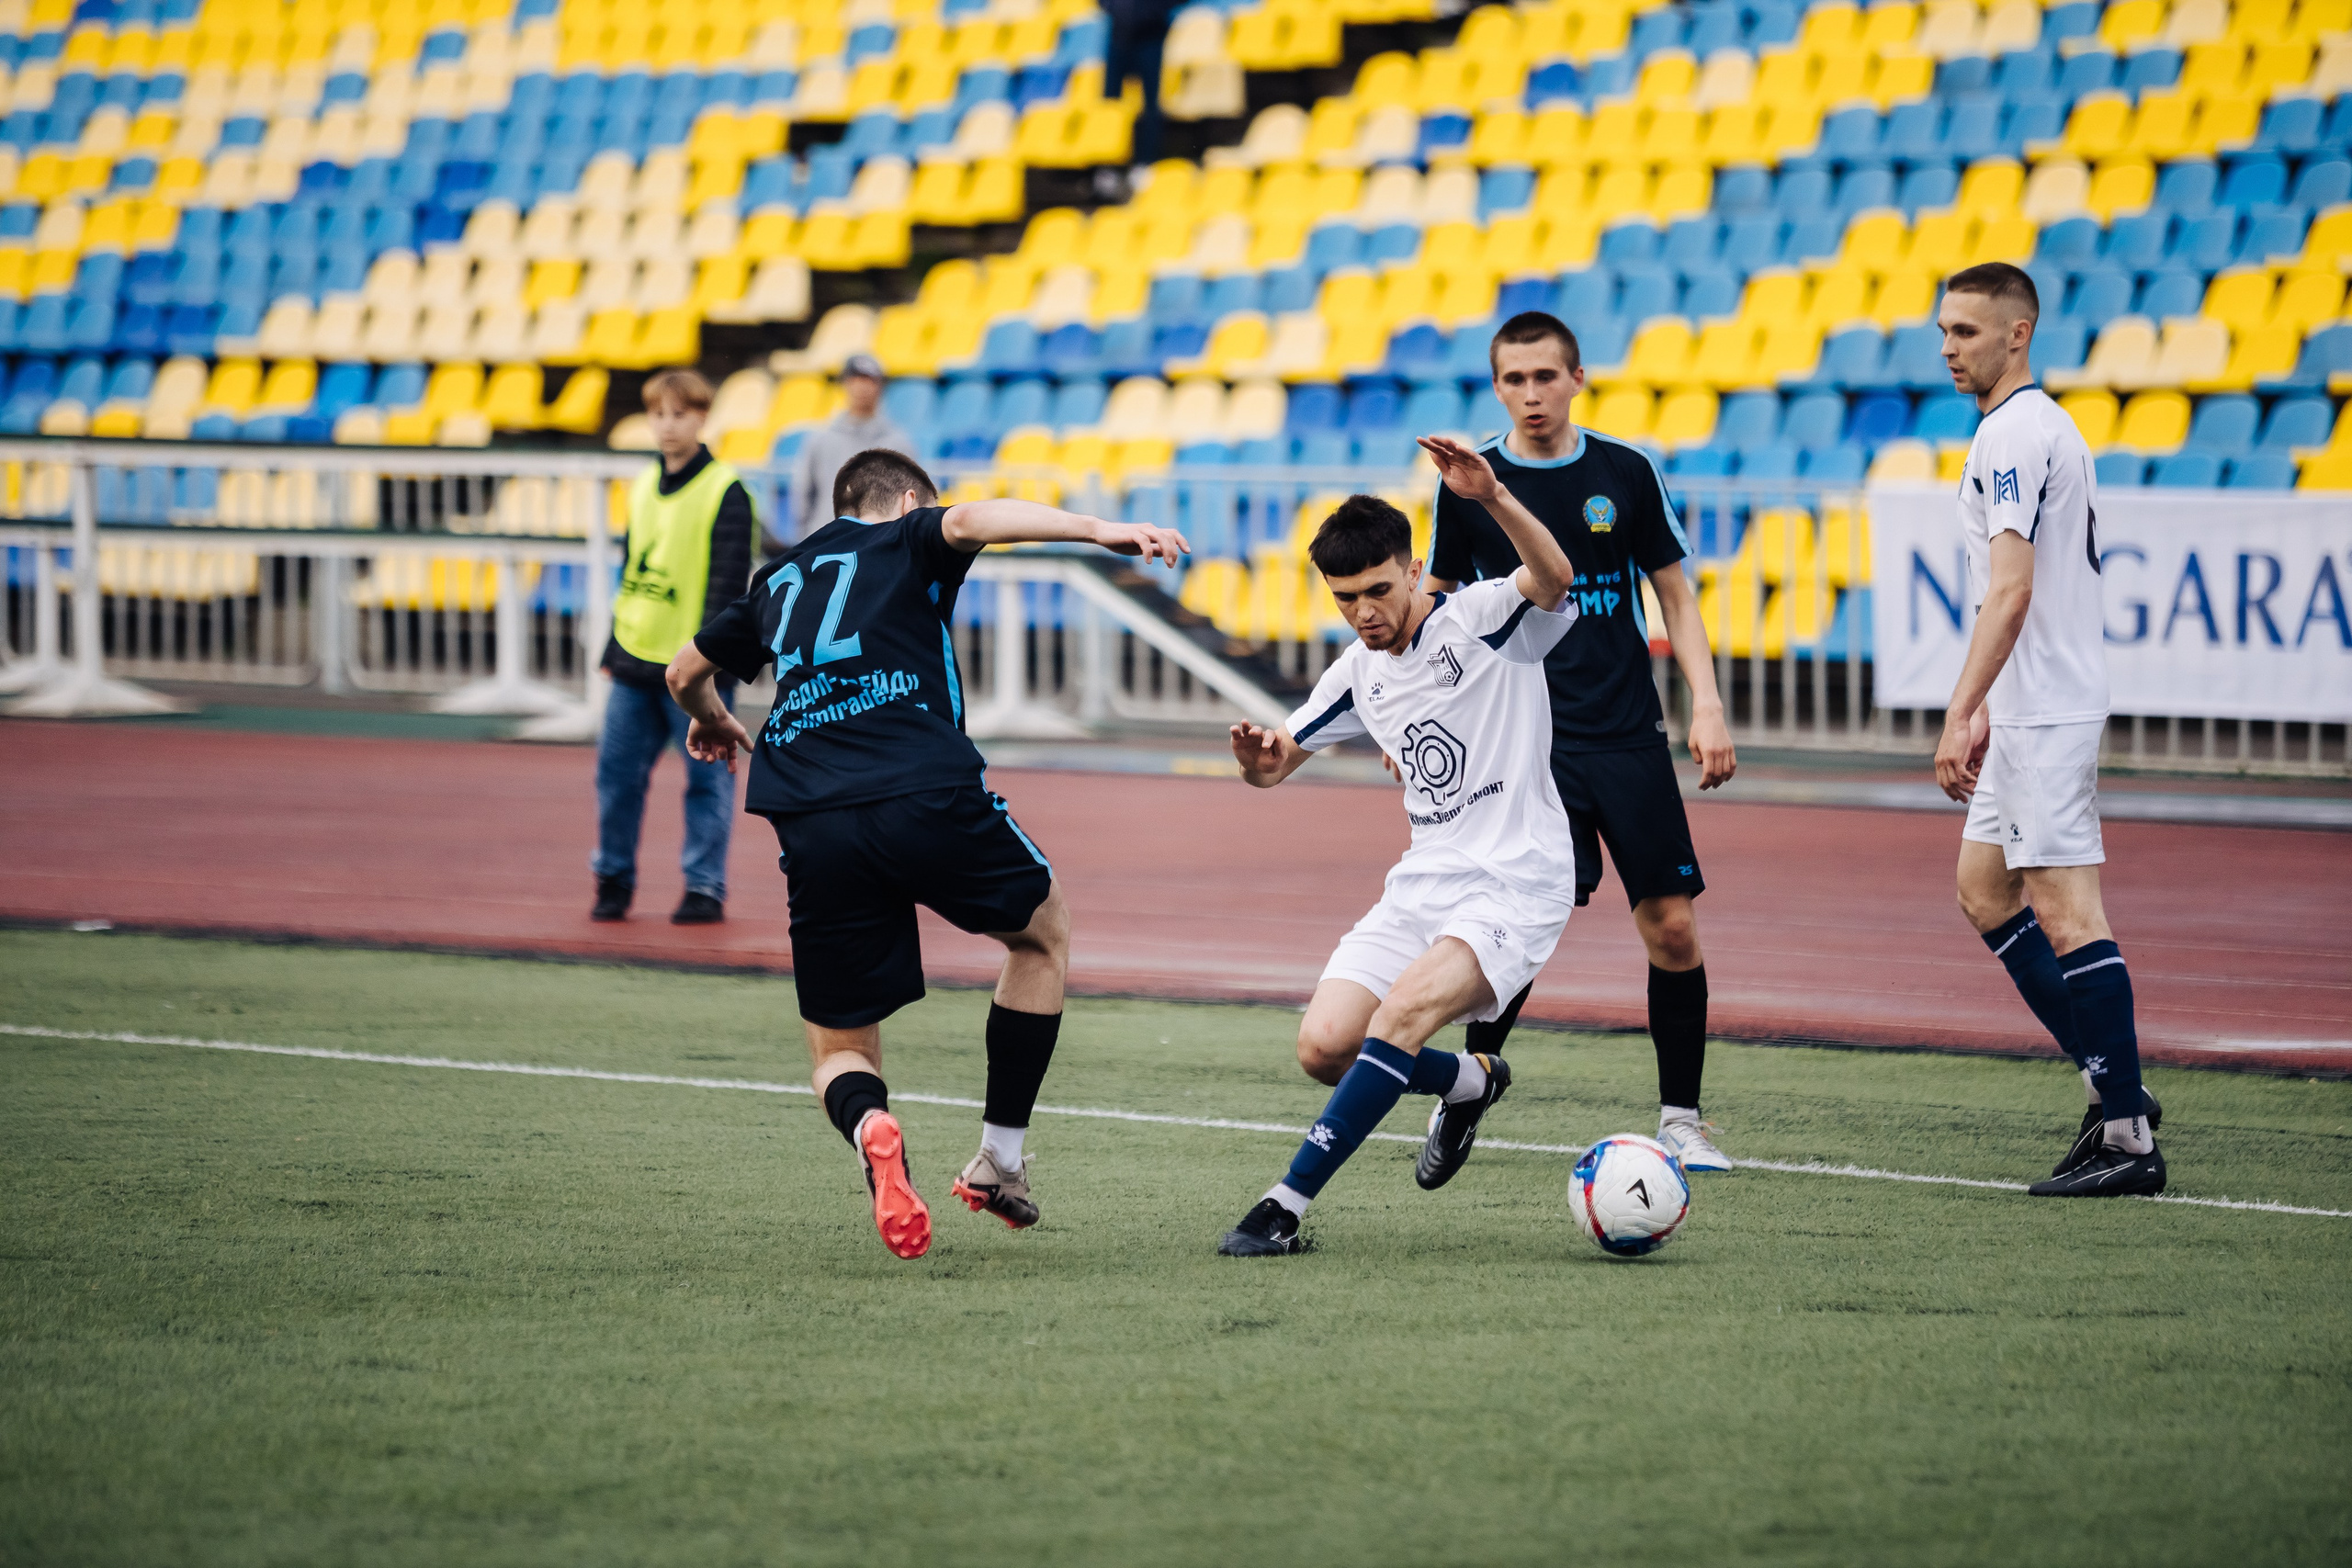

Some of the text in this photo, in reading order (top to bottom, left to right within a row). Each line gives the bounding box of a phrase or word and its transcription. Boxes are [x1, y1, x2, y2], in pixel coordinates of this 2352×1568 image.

[766, 550, 863, 682] 22
[1909, 546, 2352, 649] NGARA
[1306, 1134, 1330, 1153] KELME
